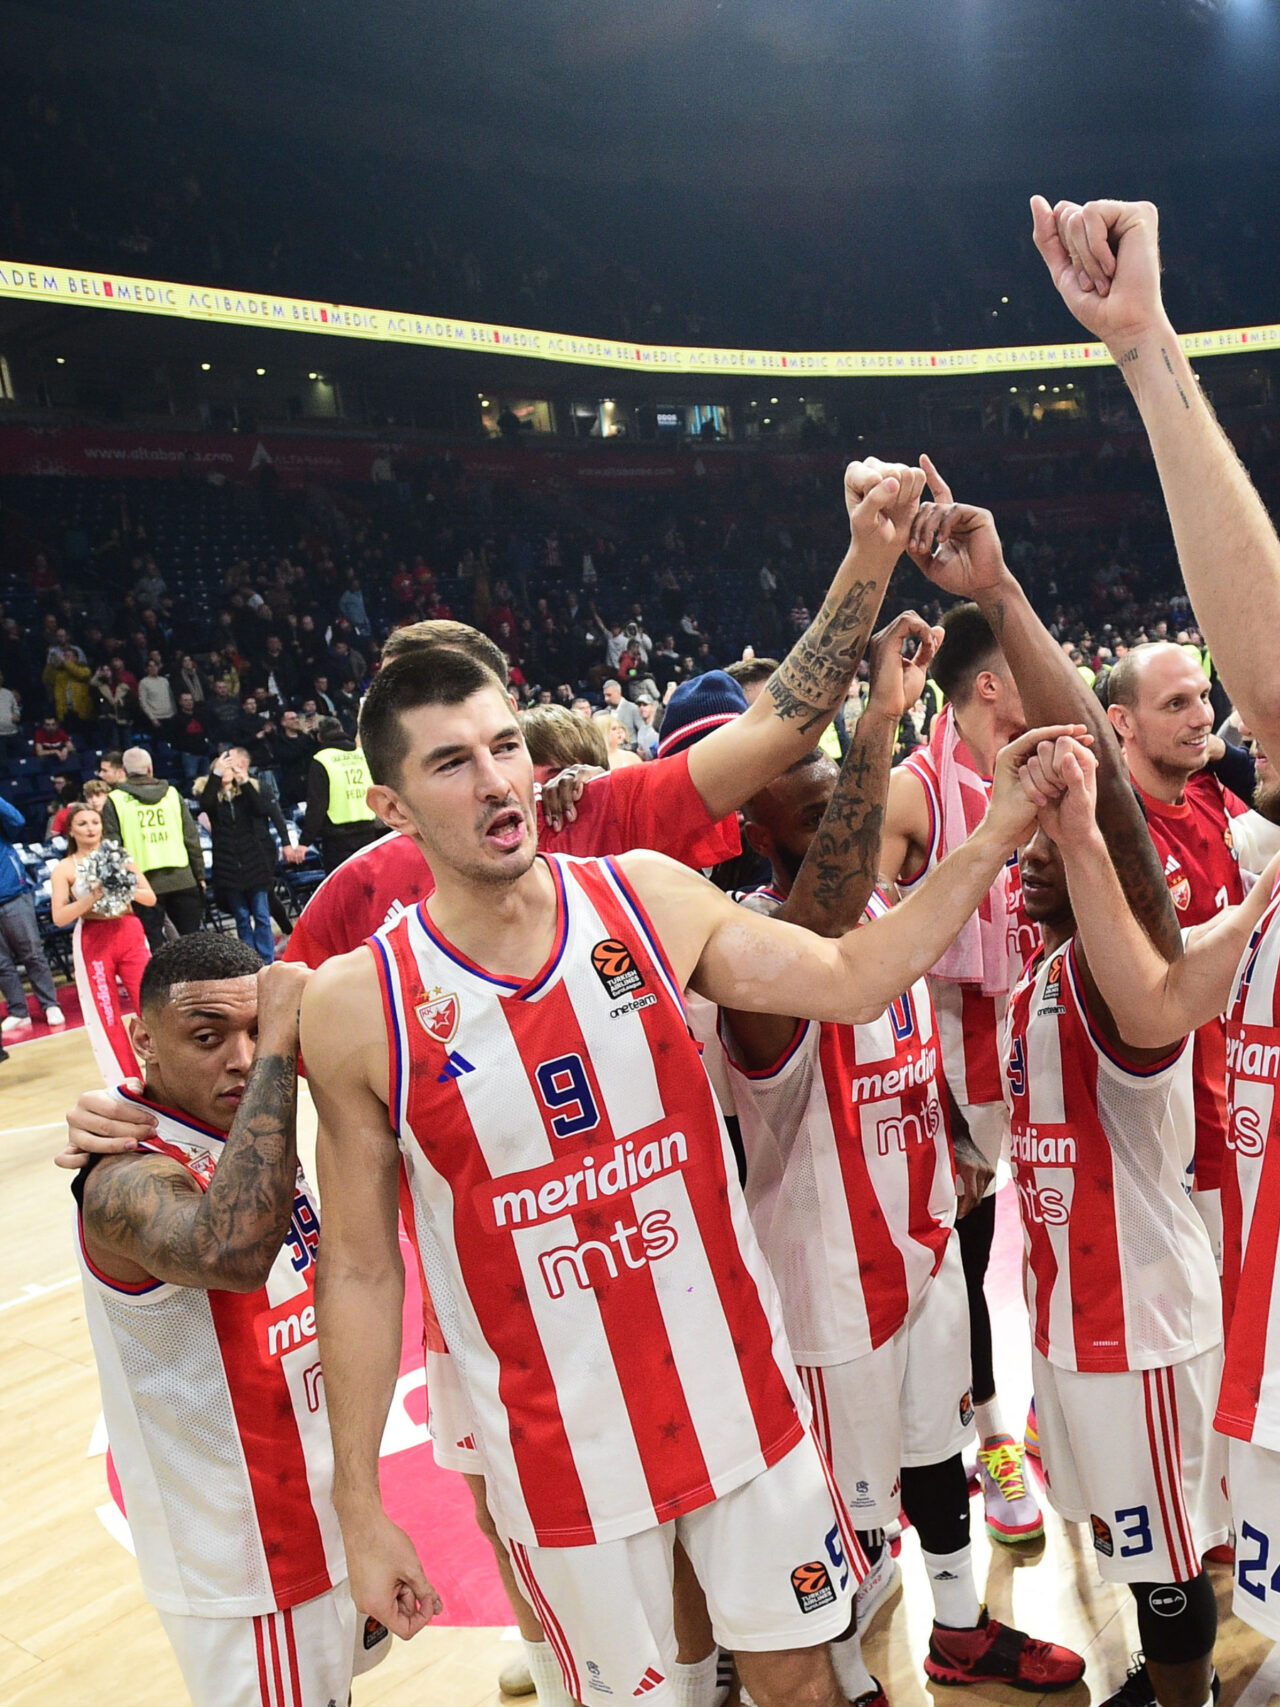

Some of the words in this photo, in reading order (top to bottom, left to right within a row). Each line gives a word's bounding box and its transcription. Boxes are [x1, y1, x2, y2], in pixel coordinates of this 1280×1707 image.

[189, 293, 285, 318] ACIBADEM
[388, 318, 464, 339] ACIBADEM
[137, 808, 165, 828] 226
[607, 970, 637, 986] TURKISH
[535, 1053, 600, 1139] 9
[877, 1099, 940, 1157] mts
[492, 1131, 688, 1227] meridian
[538, 1209, 679, 1300] mts
[1115, 1505, 1153, 1558] 3
